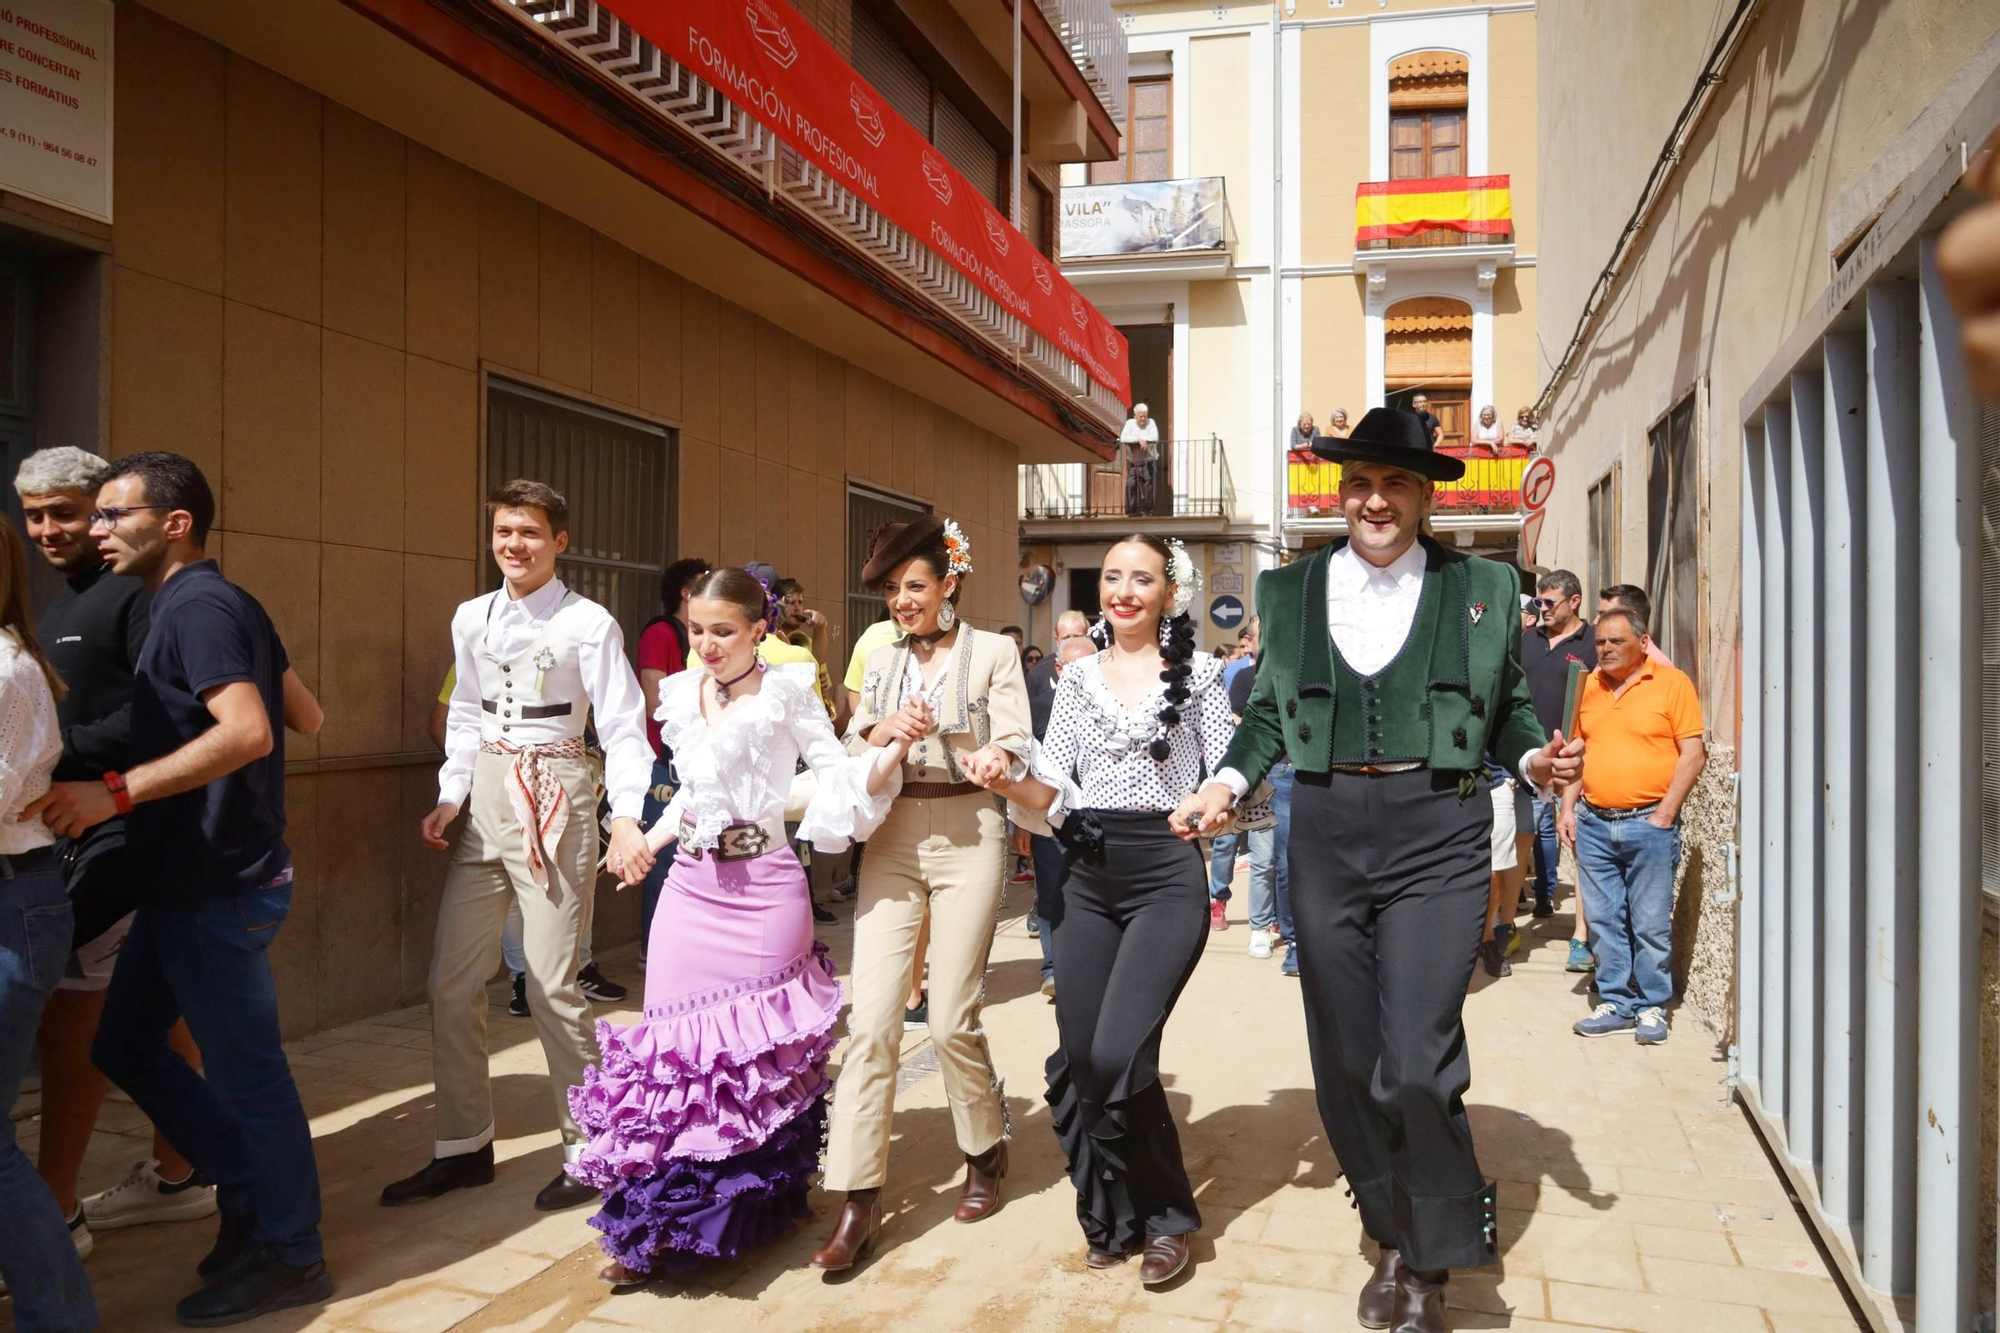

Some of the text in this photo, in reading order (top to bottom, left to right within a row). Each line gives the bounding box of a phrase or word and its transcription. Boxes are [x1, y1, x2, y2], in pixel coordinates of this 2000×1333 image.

[16, 16, 98, 60] PROFESSIONAL
[18, 46, 81, 81] CONCERTAT
[16, 75, 79, 110] FORMATIUS
[688, 26, 880, 199] FORMACIÓN PROFESIONAL
[9, 128, 16, 139] 9
[18, 132, 36, 147] (11)
[43, 141, 60, 154] 964
[61, 147, 72, 159] 56
[74, 152, 85, 163] 08
[87, 157, 98, 168] 47
[1061, 217, 1111, 229] ASSORA
[930, 220, 1032, 318] FORMACIÓN PROFESIONAL
